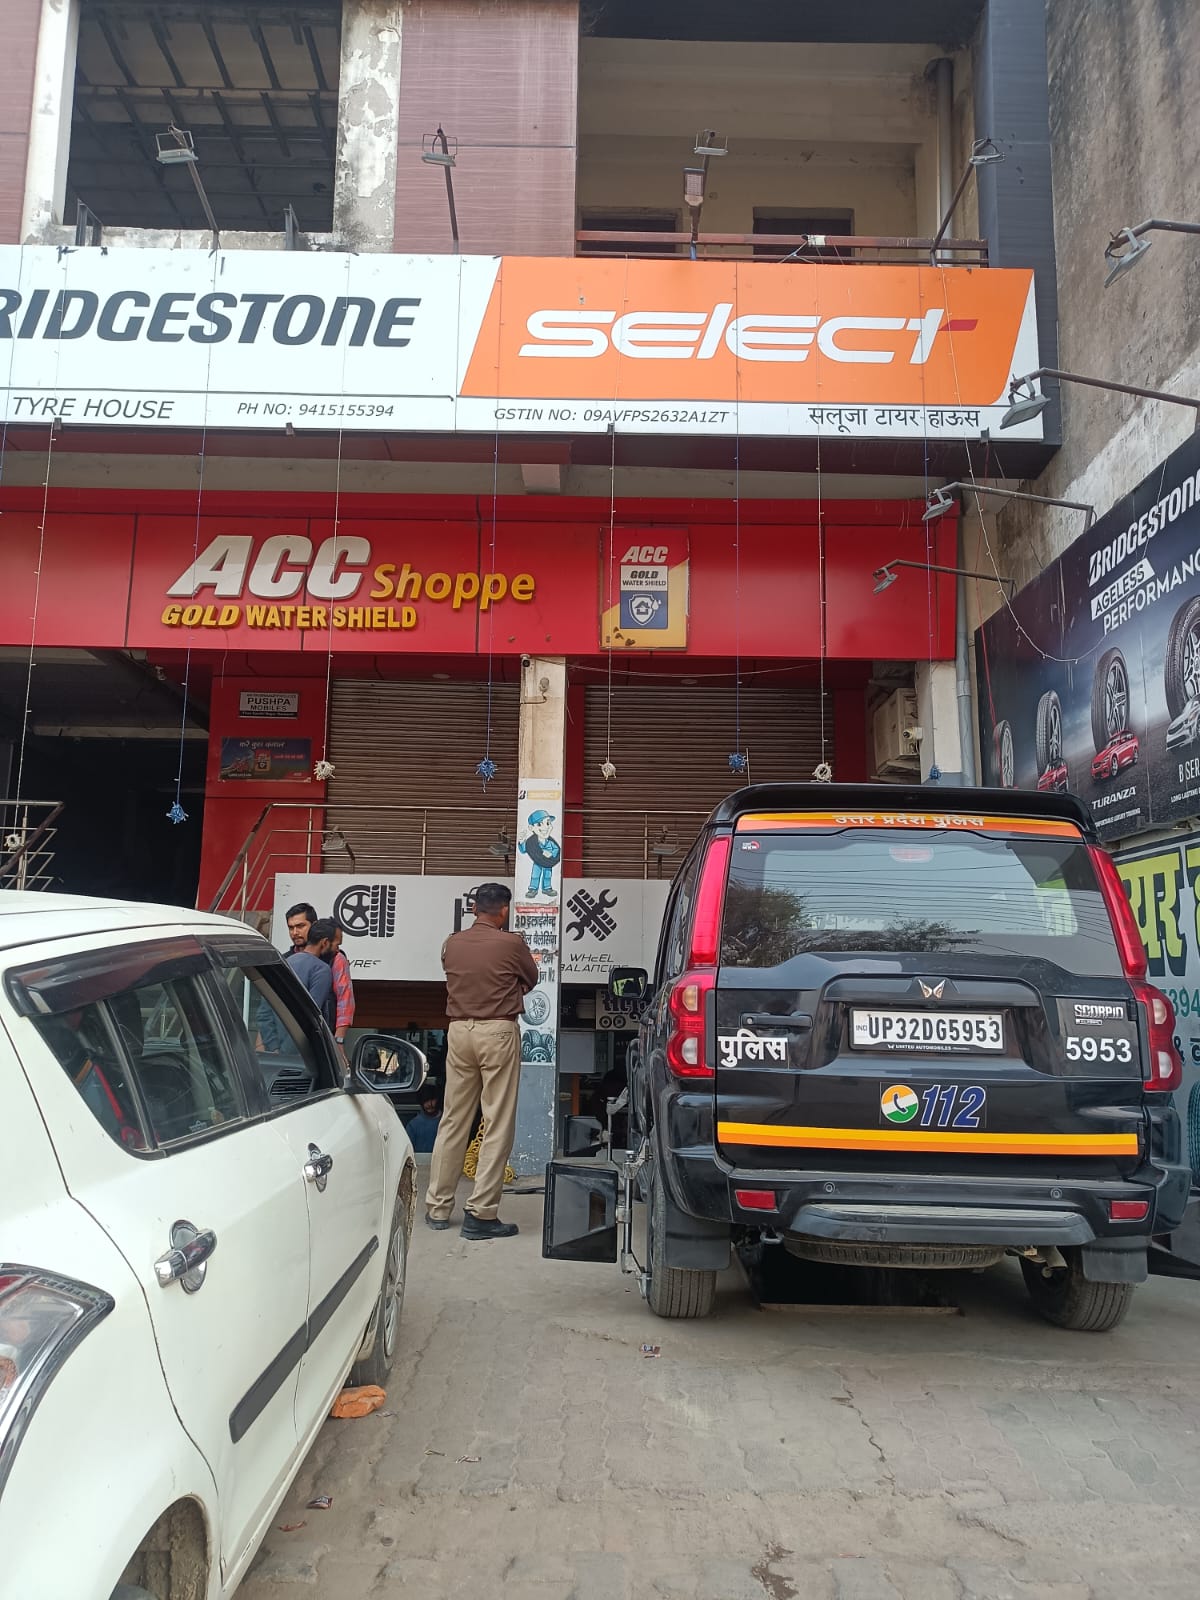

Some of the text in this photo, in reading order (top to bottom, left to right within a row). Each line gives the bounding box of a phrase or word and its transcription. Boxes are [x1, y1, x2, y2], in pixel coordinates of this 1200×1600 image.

[13, 397, 175, 419] TYRE HOUSE
[237, 402, 394, 417] PH NO: 9415155394
[494, 408, 728, 423] GSTIN NO: 09AVFPS2632A1ZT
[808, 407, 980, 433] सलूजा टायर हाऊस
[620, 546, 668, 563] ACC
[166, 534, 535, 610] ACC Shoppe
[630, 570, 659, 579] GOLD
[1095, 563, 1145, 616] AGELESS
[161, 604, 418, 630] GOLD WATER SHIELD
[247, 697, 291, 705] PUSHPA
[1092, 786, 1136, 809] TURANZA
[832, 813, 984, 828] उत्तर प्रदेश पुलिस
[1160, 987, 1200, 1017] 394
[869, 1016, 1001, 1042] UP32DG5953
[717, 1028, 788, 1067] पुलिस
[1066, 1037, 1132, 1063] 5953
[920, 1084, 986, 1128] 112
